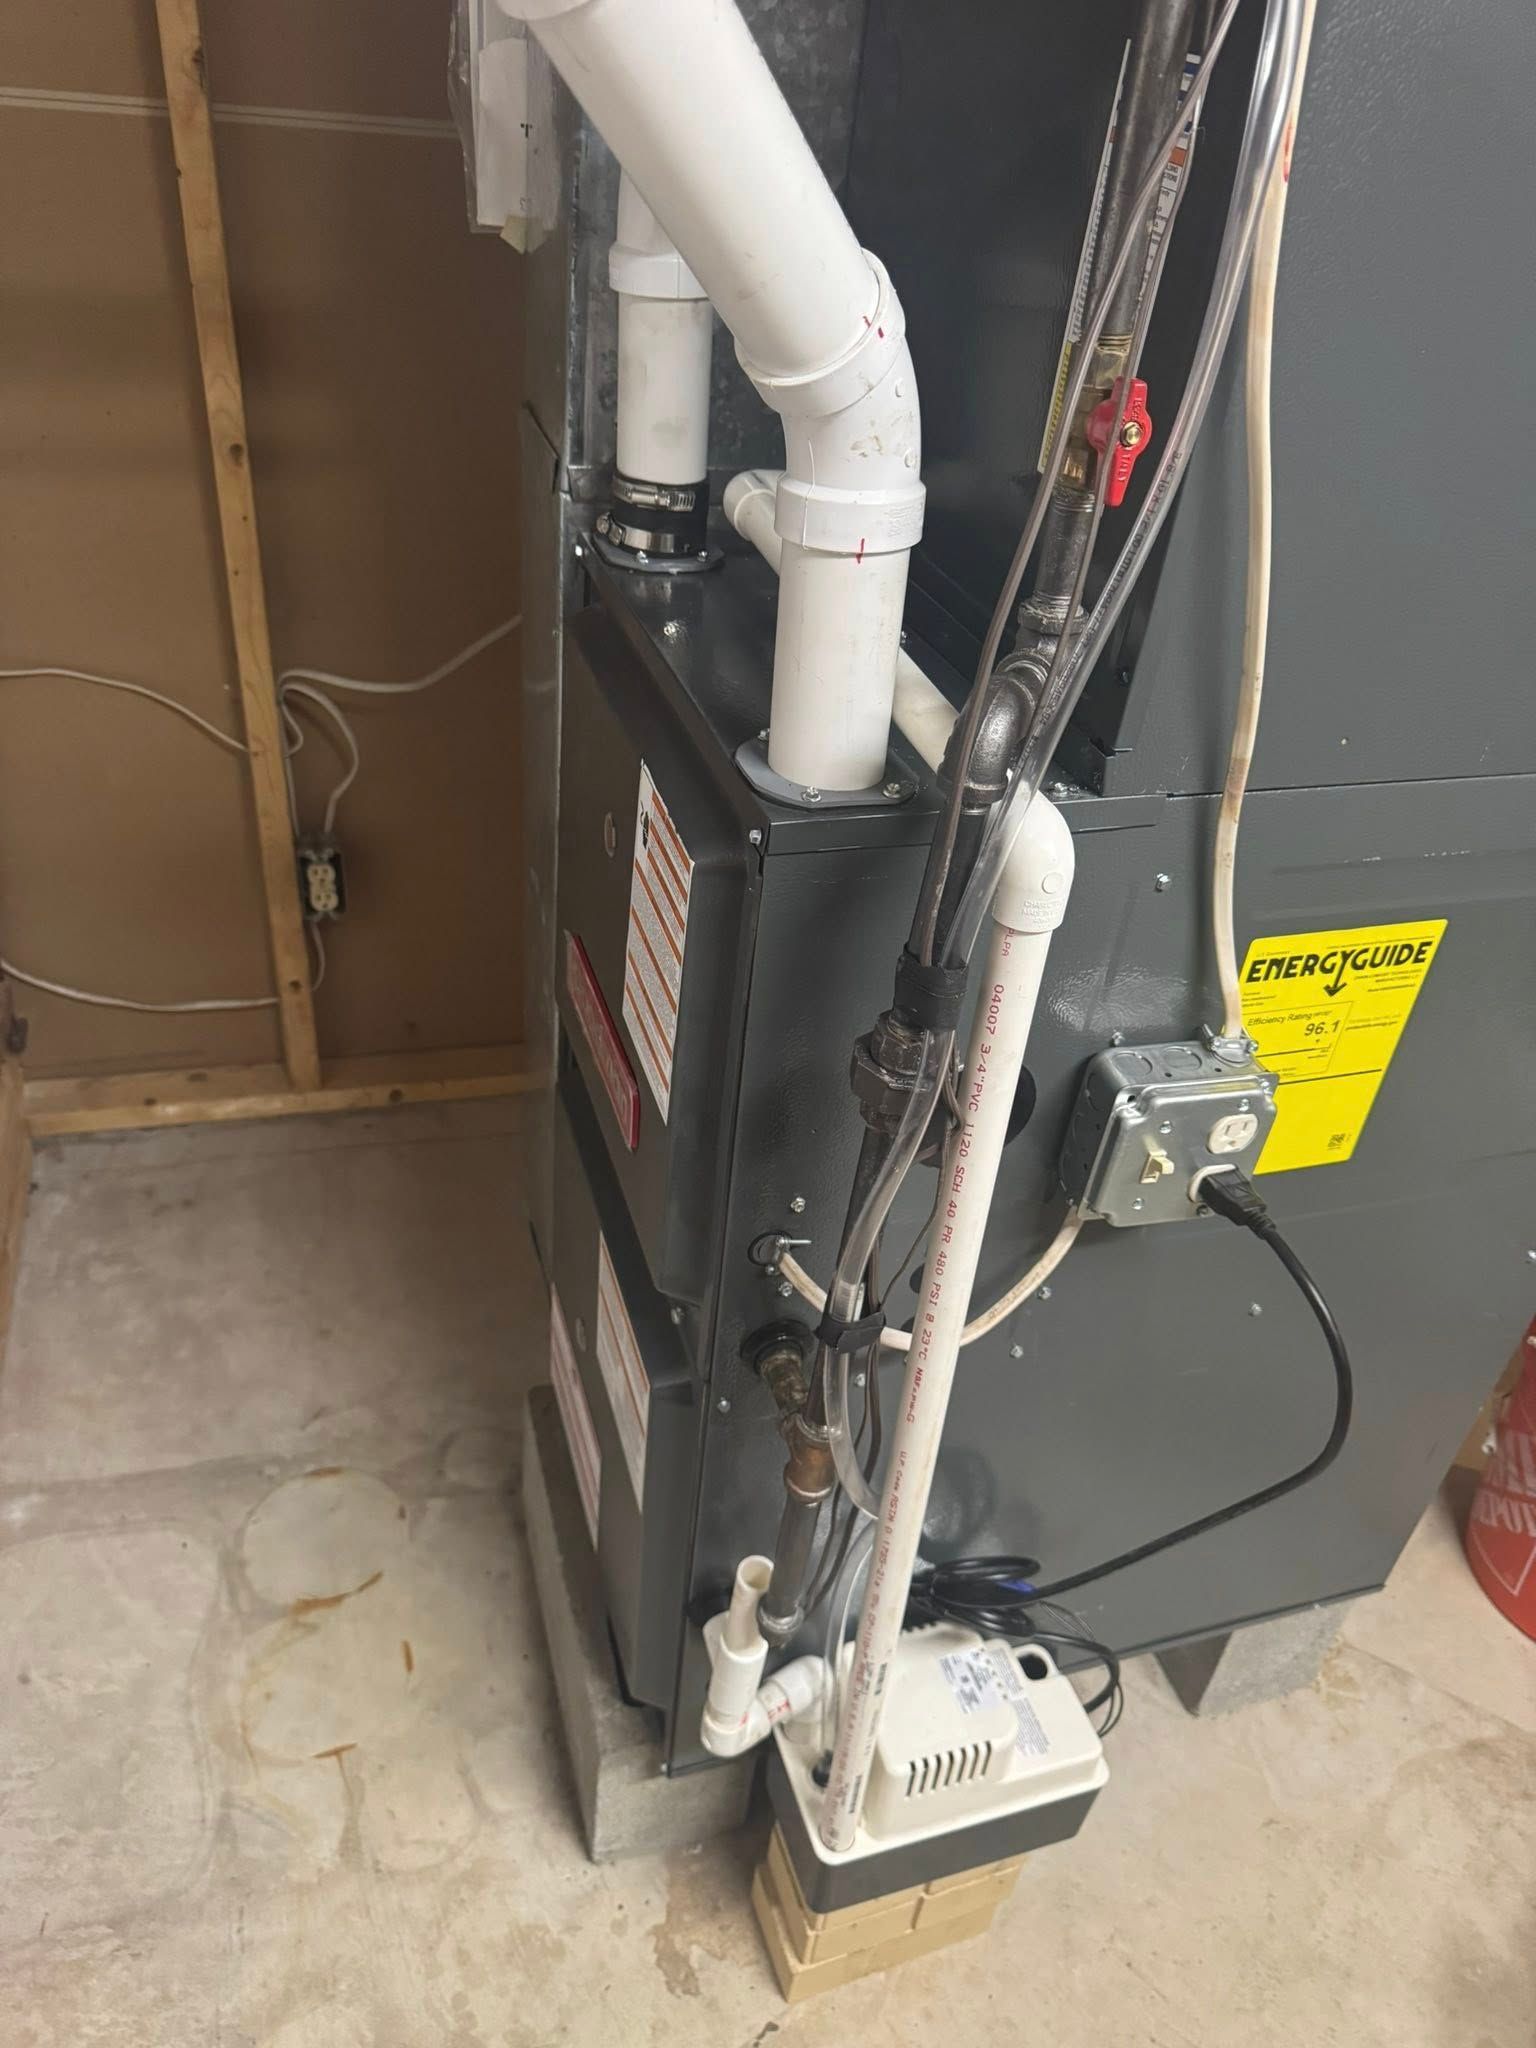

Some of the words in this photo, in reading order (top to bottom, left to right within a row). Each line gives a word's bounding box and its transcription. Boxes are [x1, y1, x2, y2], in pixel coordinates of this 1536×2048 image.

[1245, 940, 1434, 985] ENERGYGUIDE
[985, 984, 1005, 1036] 04007
[1247, 1016, 1286, 1027] Efficiency
[1287, 1012, 1313, 1022] Rating
[1304, 1019, 1340, 1037] 96.1
[958, 1121, 974, 1158] 1120
[951, 1164, 966, 1194] SCH
[945, 1198, 958, 1219] 40
[941, 1224, 955, 1245] PR
[933, 1249, 947, 1277] 480
[928, 1280, 943, 1306] PSI
